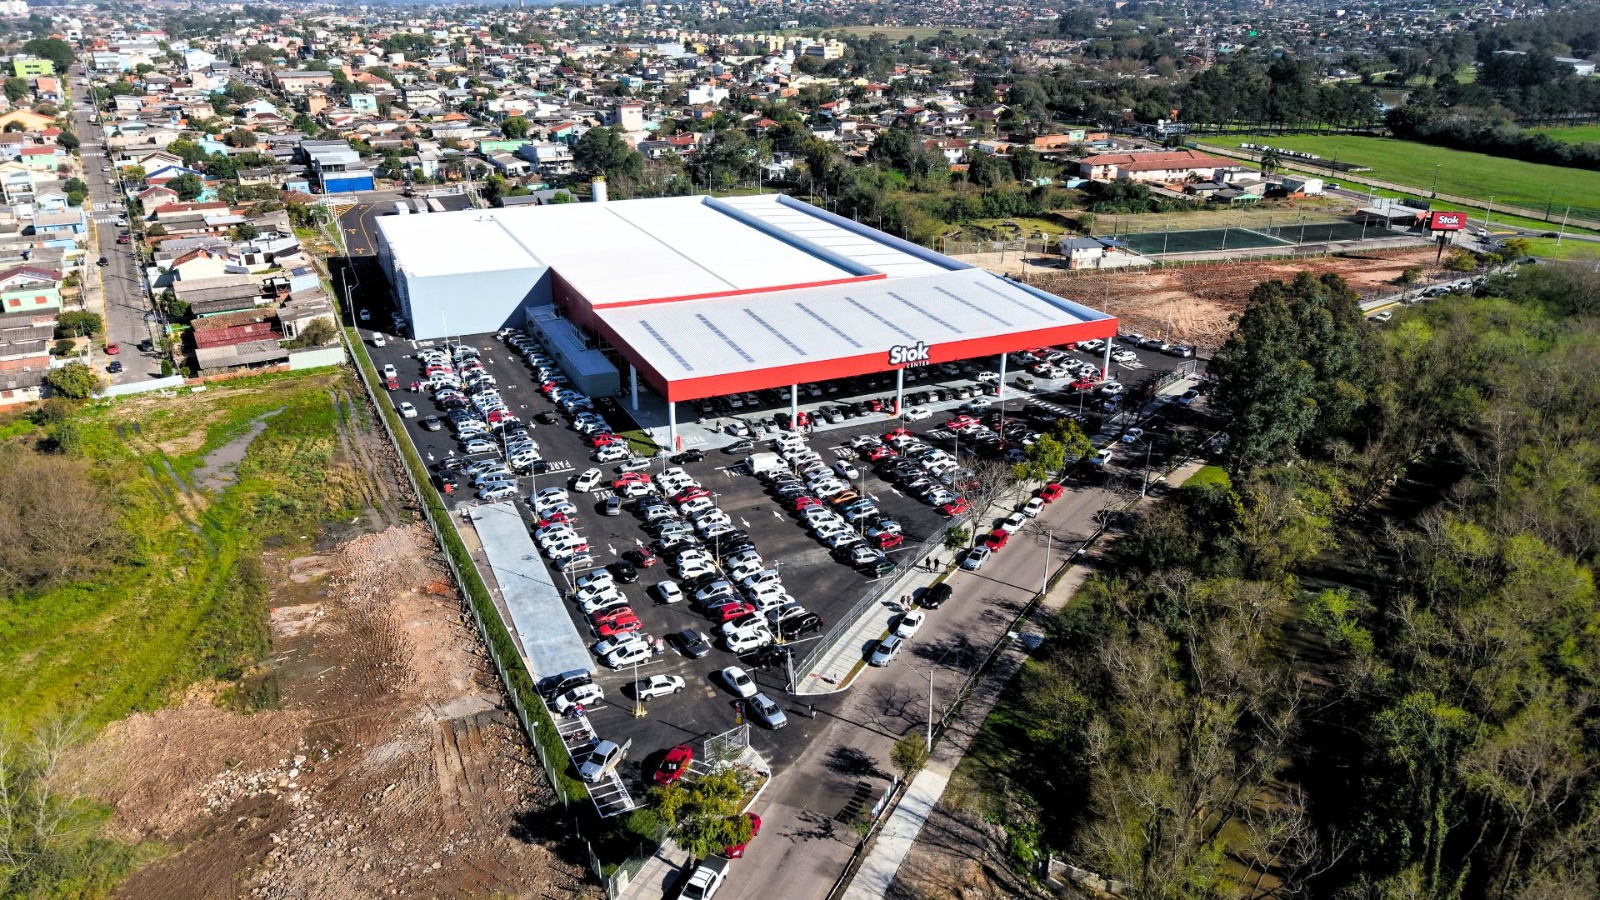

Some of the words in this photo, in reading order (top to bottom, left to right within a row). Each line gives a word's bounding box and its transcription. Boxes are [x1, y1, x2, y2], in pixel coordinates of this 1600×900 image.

[1438, 216, 1459, 224] Stok
[889, 341, 930, 365] Stok
[906, 361, 930, 369] CENTER
